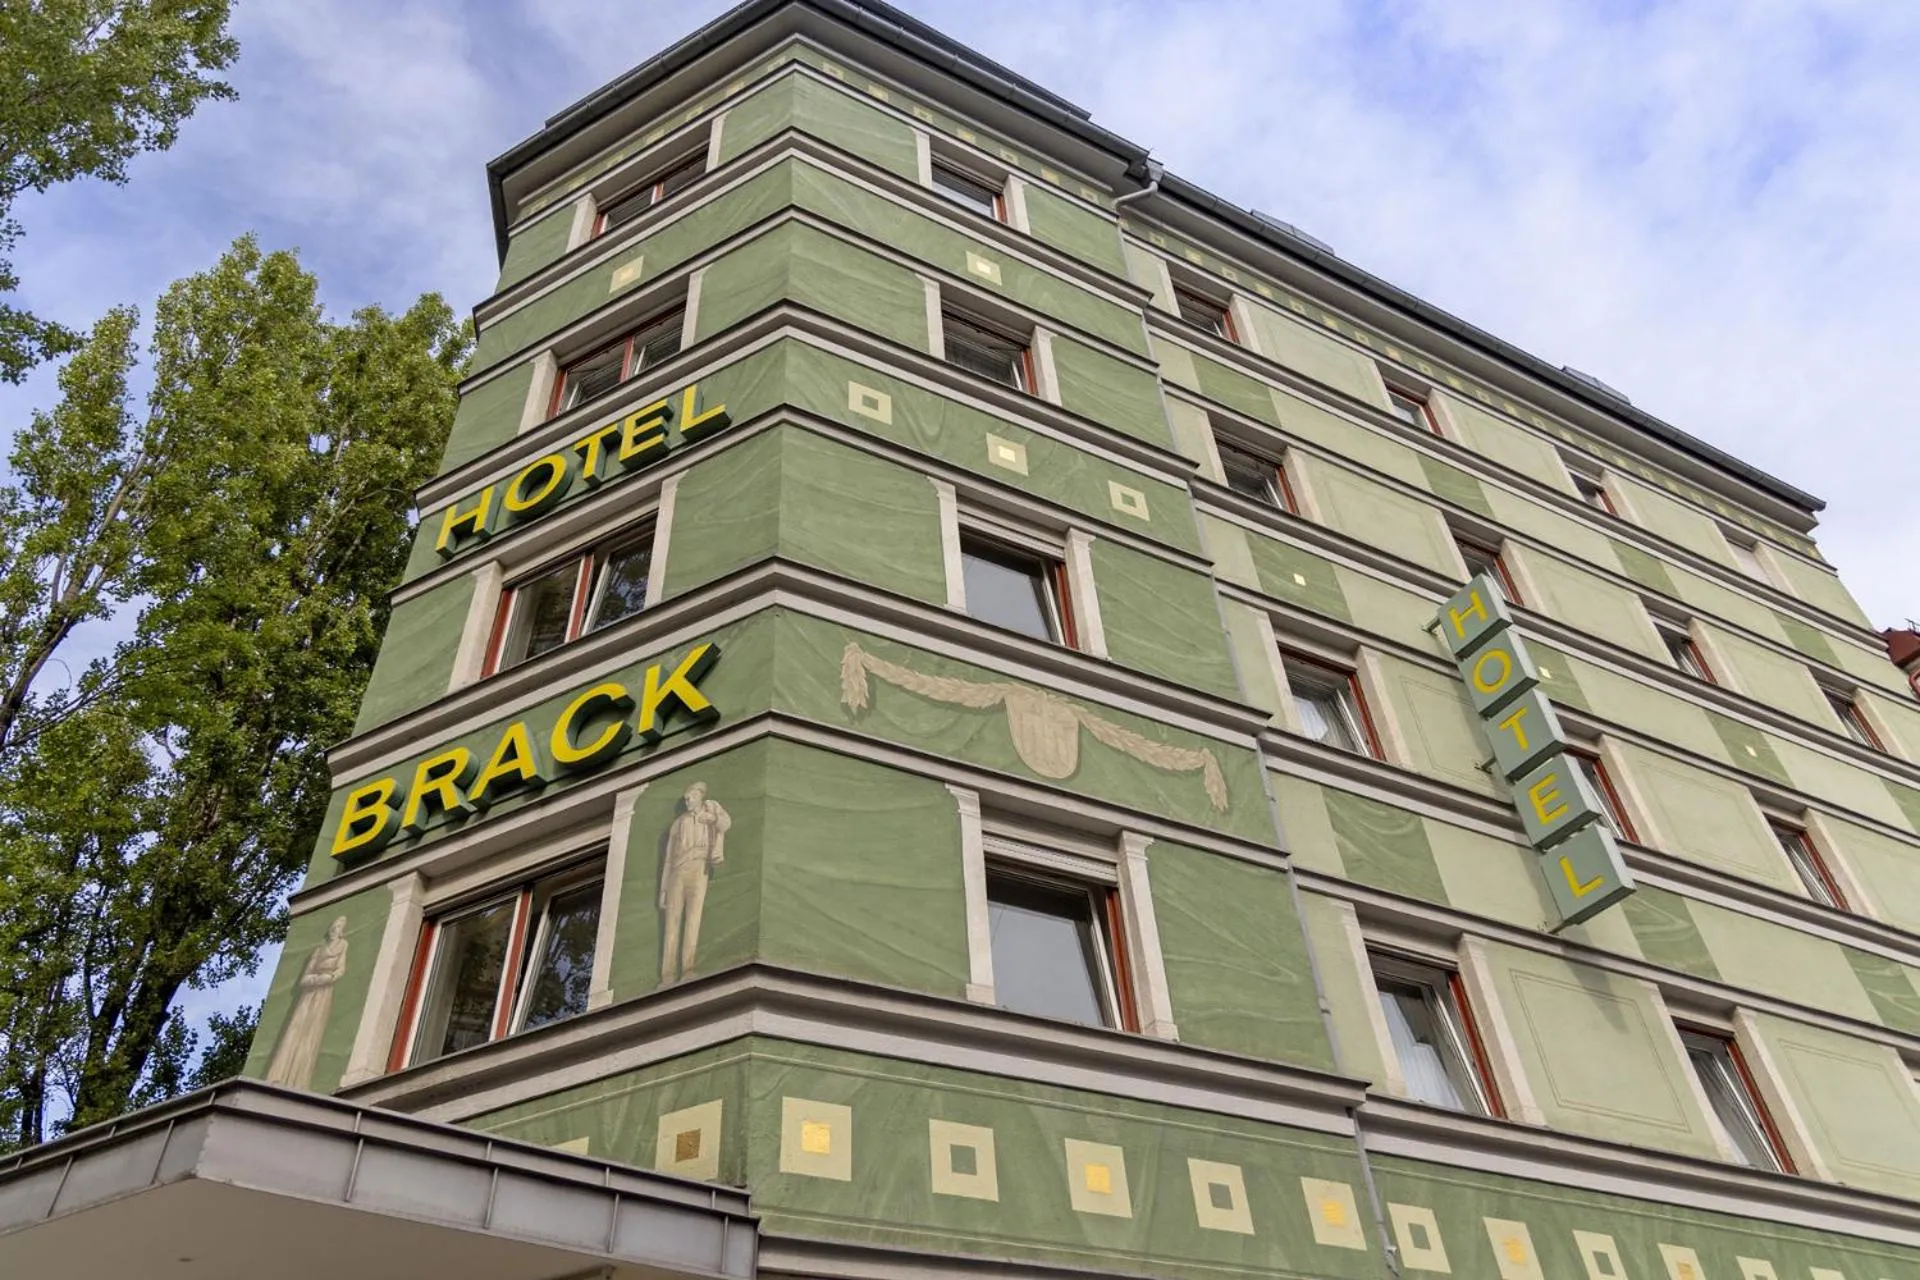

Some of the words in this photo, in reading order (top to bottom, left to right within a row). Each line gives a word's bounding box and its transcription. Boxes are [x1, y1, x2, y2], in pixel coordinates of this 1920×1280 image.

[435, 383, 730, 557] HOTEL
[330, 642, 720, 860] BRACK
[1449, 591, 1604, 898] HOTEL
